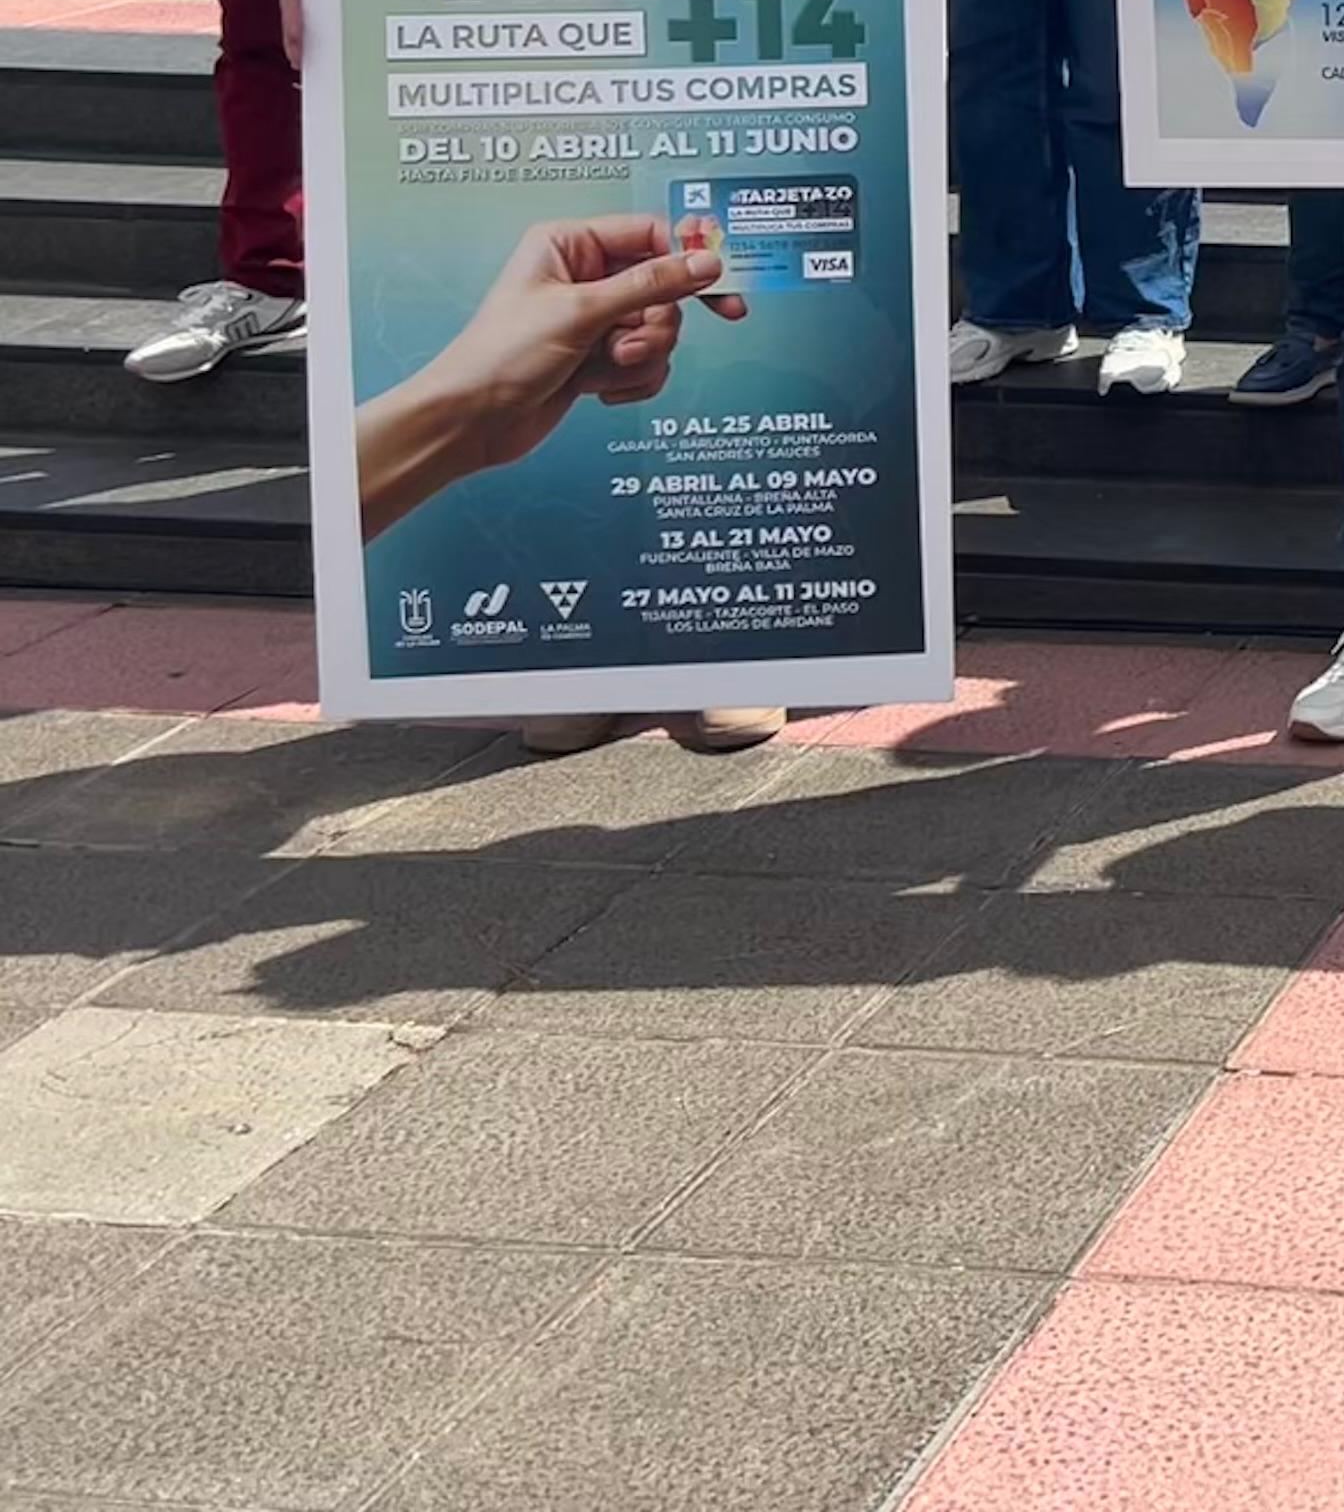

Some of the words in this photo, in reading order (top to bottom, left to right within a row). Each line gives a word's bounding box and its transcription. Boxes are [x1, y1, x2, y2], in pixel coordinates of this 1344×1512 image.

[397, 24, 442, 49] LA
[453, 23, 547, 48] RUTA
[558, 22, 632, 51] QUE
[399, 81, 602, 107] MULTIPLICA
[611, 79, 675, 103] TUS
[686, 74, 856, 100] COMPRAS
[785, 111, 856, 125] CONSUMO
[400, 137, 472, 163] DEL
[481, 136, 520, 162] 10
[529, 133, 641, 160] ABRIL
[650, 131, 698, 157] AL
[706, 130, 736, 155] 11
[746, 125, 858, 154] JUNIO
[400, 167, 459, 183] HASTA
[461, 168, 488, 182] FIN
[494, 167, 516, 181] DE
[522, 165, 629, 181] EXISTENCIAS
[740, 186, 852, 204] TARJETAZO
[811, 258, 848, 272] VISA
[651, 419, 677, 436] 10
[684, 417, 717, 435] AL
[722, 416, 751, 434] 25
[757, 413, 833, 432] ABRIL
[666, 450, 696, 463] SAN
[755, 448, 764, 459] Y
[767, 445, 820, 459] SAUCES
[610, 477, 641, 495] 29
[646, 474, 722, 493] ABRIL
[728, 473, 761, 490] AL
[767, 471, 797, 488] 09
[803, 468, 877, 487] MAYO
[653, 493, 743, 507] PUNTALLANA
[803, 489, 837, 501] ALTA
[656, 506, 702, 520] SANTA
[704, 505, 741, 518] CRUZ
[744, 504, 763, 516] DE
[766, 503, 785, 515] LA
[786, 501, 834, 514] PALMA
[660, 531, 684, 549] 13
[690, 529, 724, 548] AL
[729, 528, 752, 546] 21
[759, 525, 832, 544] MAYO
[640, 550, 740, 565] FUENCALIENTE
[751, 548, 790, 560] VILLA
[792, 547, 811, 558] DE
[814, 545, 854, 557] MAZO
[621, 590, 651, 608] 27
[658, 586, 731, 606] MAYO
[736, 585, 770, 603] AL
[775, 584, 795, 601] 11
[801, 580, 877, 600] JUNIO
[714, 605, 793, 619] TAZACORTE
[803, 603, 819, 615] EL
[821, 602, 859, 615] PASO
[451, 620, 528, 636] SODEPAL
[666, 621, 693, 633] LOS
[696, 618, 749, 632] LLANOS
[752, 617, 771, 630] DE
